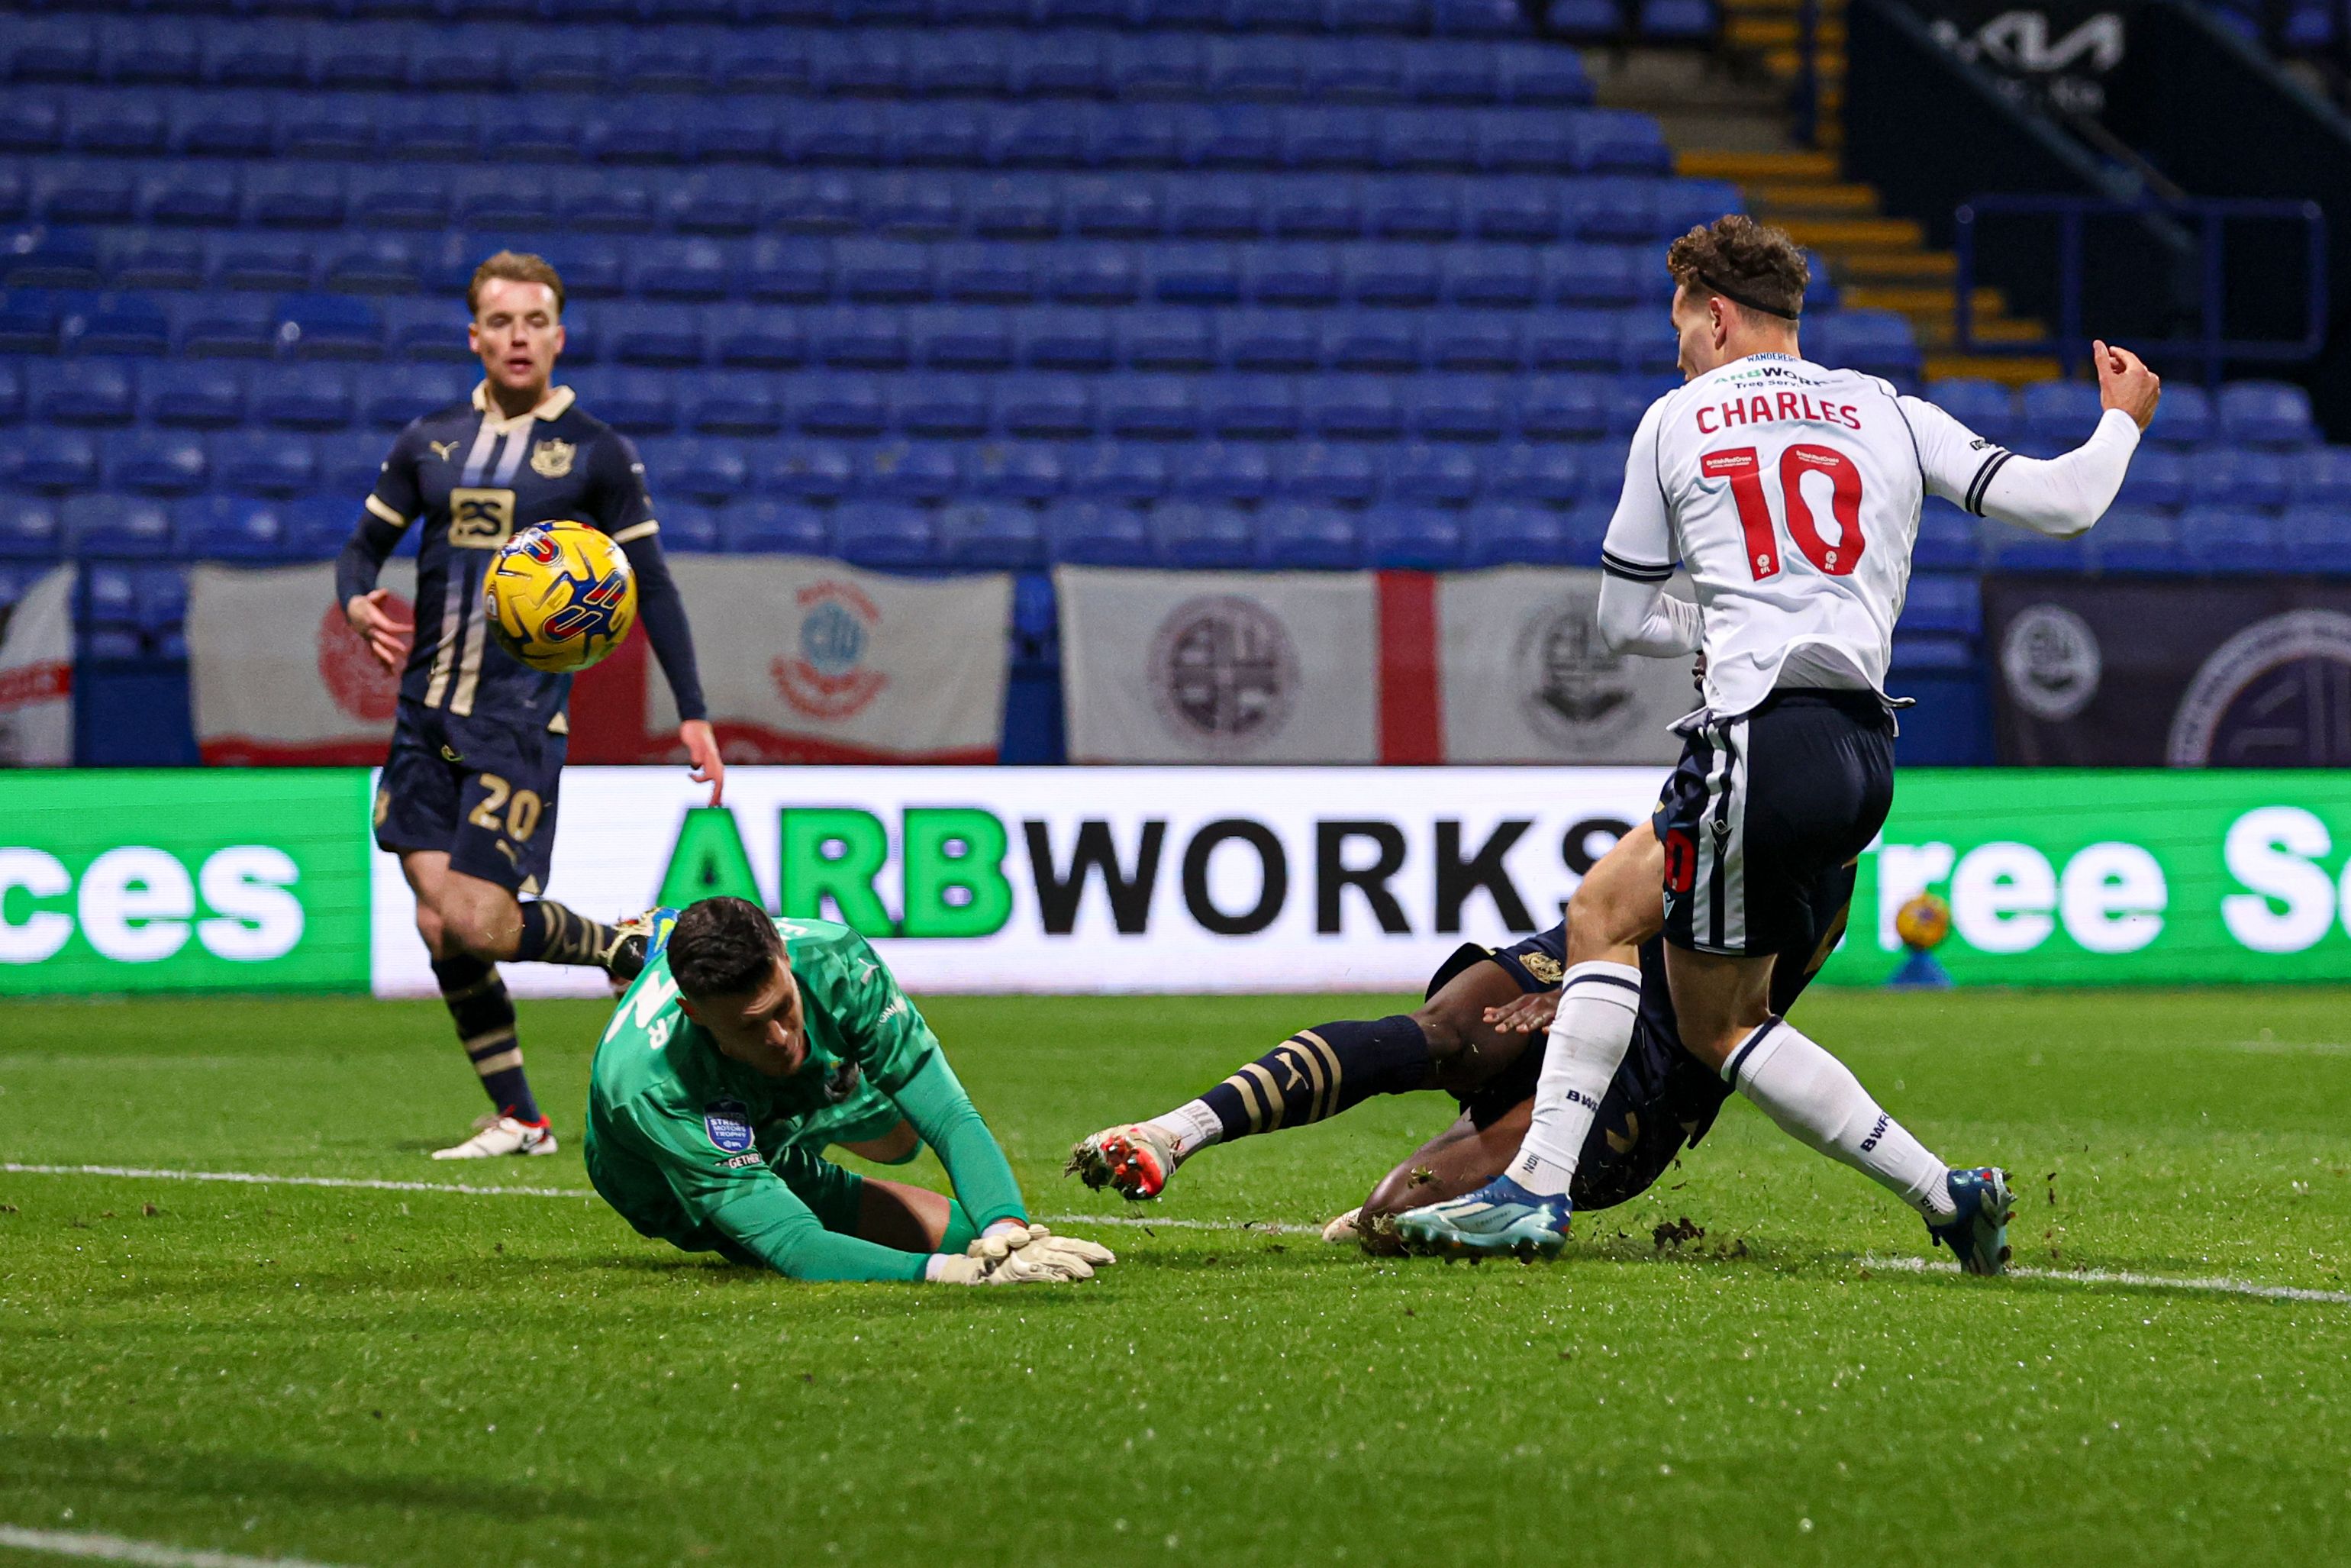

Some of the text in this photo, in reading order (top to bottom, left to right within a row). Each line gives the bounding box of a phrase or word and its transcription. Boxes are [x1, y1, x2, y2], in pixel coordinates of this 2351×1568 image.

[1696, 391, 1861, 434] CHARLES
[1700, 444, 1866, 582] 10
[468, 773, 542, 843] 20
[1832, 805, 2351, 953] ree S
